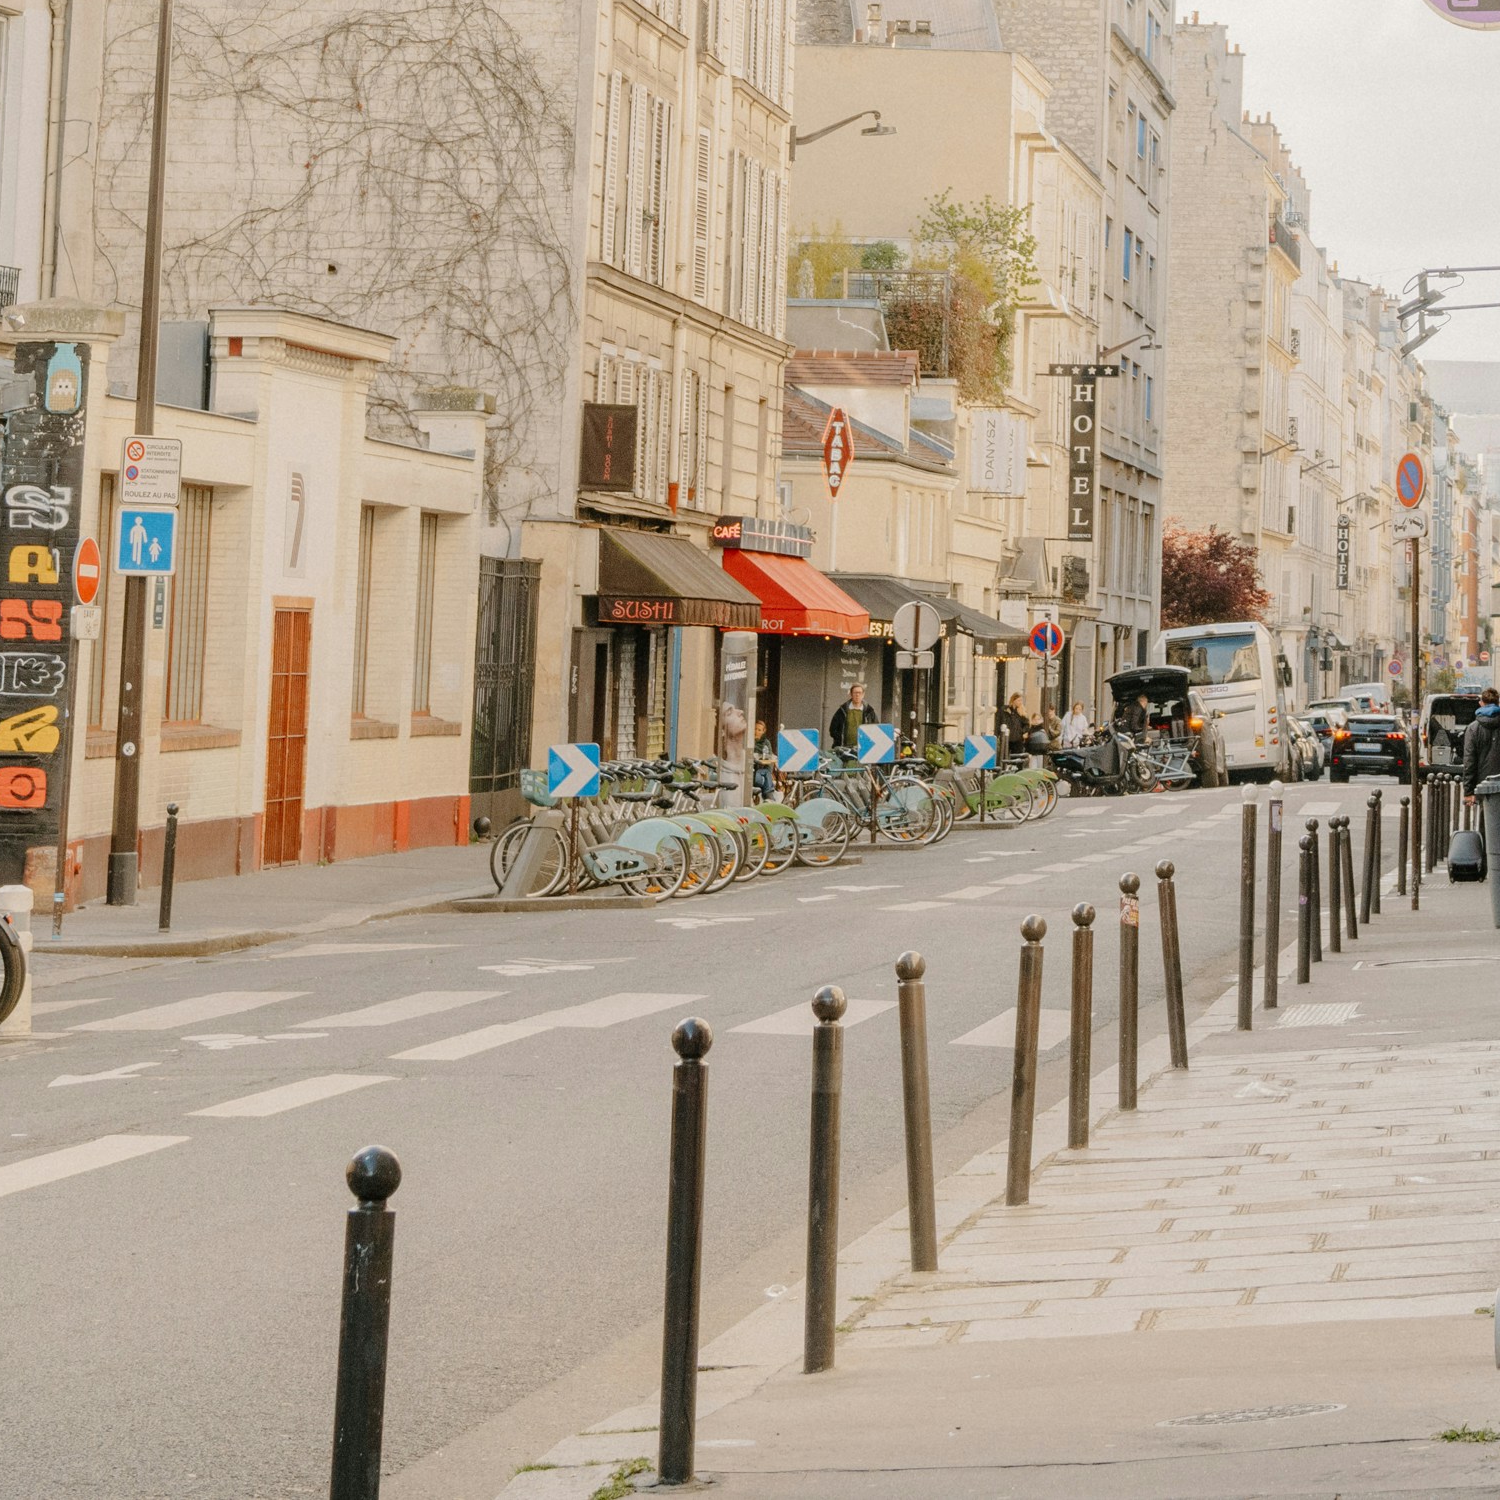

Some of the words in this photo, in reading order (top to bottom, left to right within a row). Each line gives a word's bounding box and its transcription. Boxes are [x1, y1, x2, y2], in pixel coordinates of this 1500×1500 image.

[829, 421, 845, 487] TABAC
[984, 419, 996, 480] DANYSZ
[1071, 384, 1095, 526] HOTEL
[713, 522, 741, 539] CAFÉ
[1337, 528, 1349, 587] HOTEL
[612, 600, 674, 619] SUSHI
